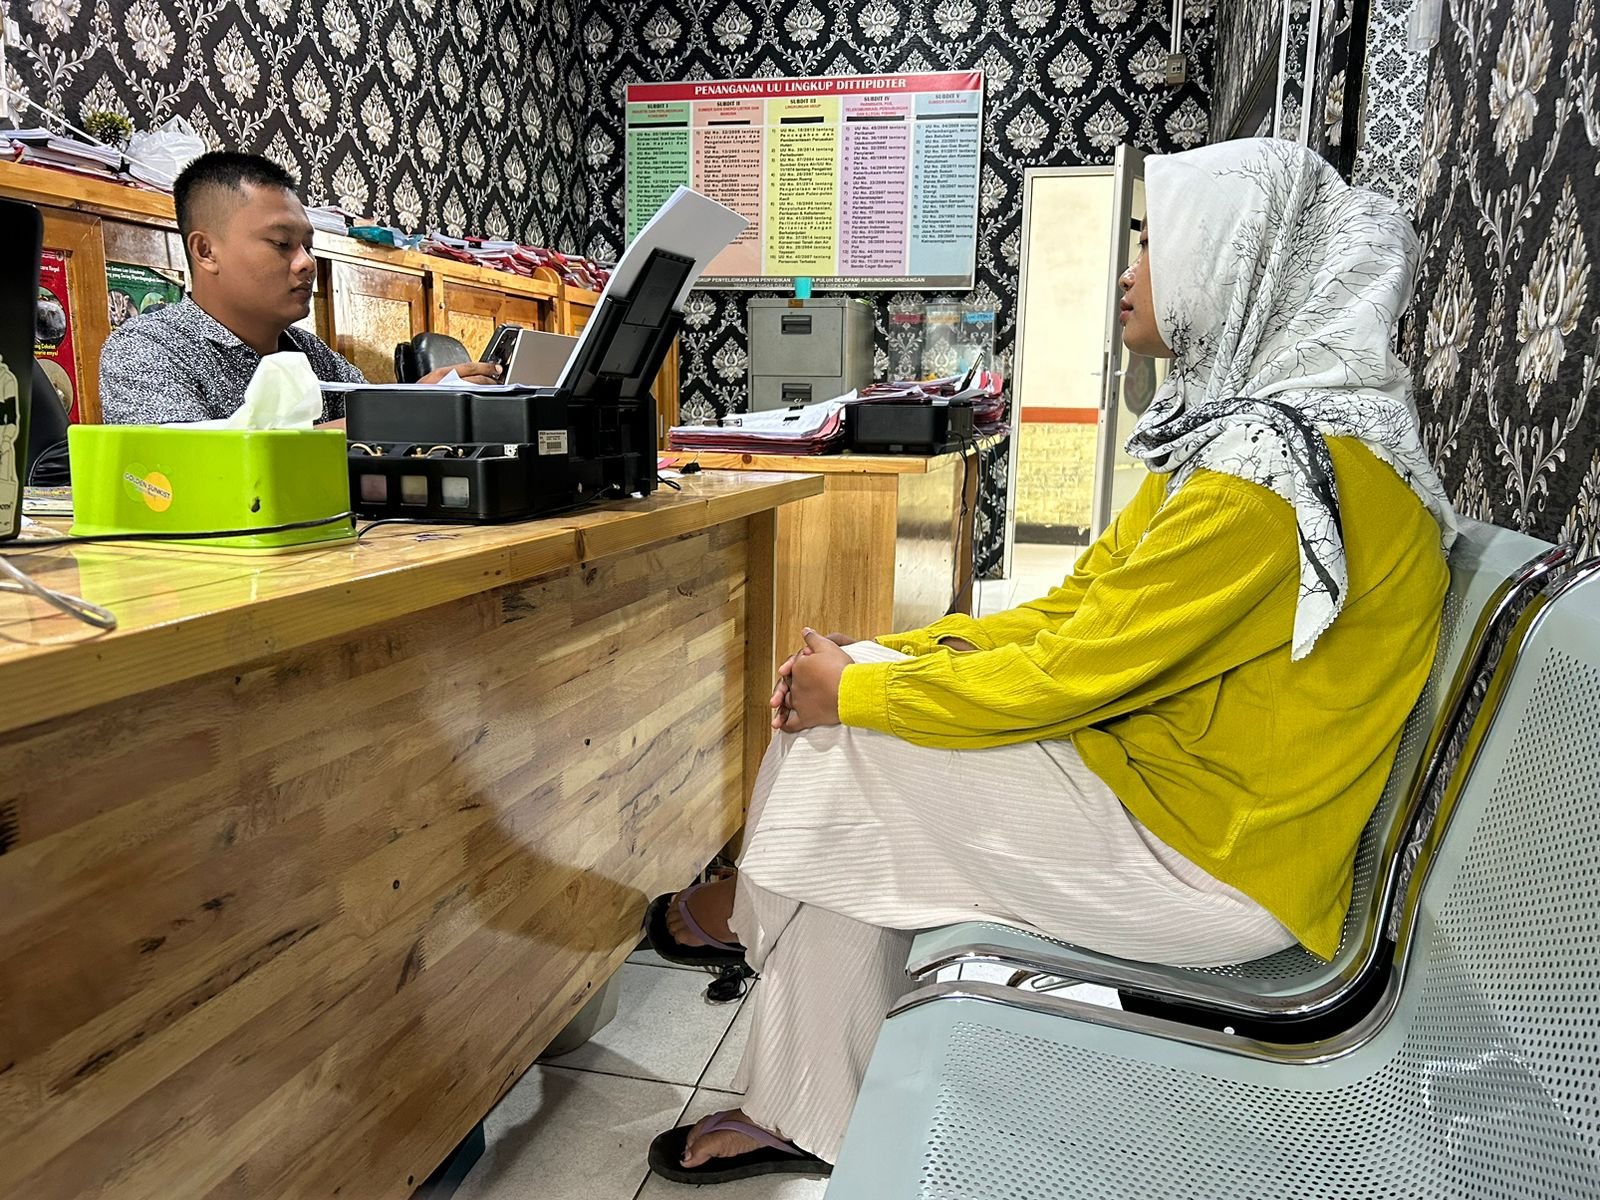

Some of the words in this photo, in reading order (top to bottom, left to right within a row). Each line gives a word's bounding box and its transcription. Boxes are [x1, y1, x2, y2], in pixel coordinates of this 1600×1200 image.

[694, 83, 765, 96] PENANGANAN
[767, 82, 782, 93] UU
[785, 80, 833, 92] LINGKUP
[836, 78, 906, 90] DITTIPIDTER
[125, 472, 148, 488] GOLDEN
